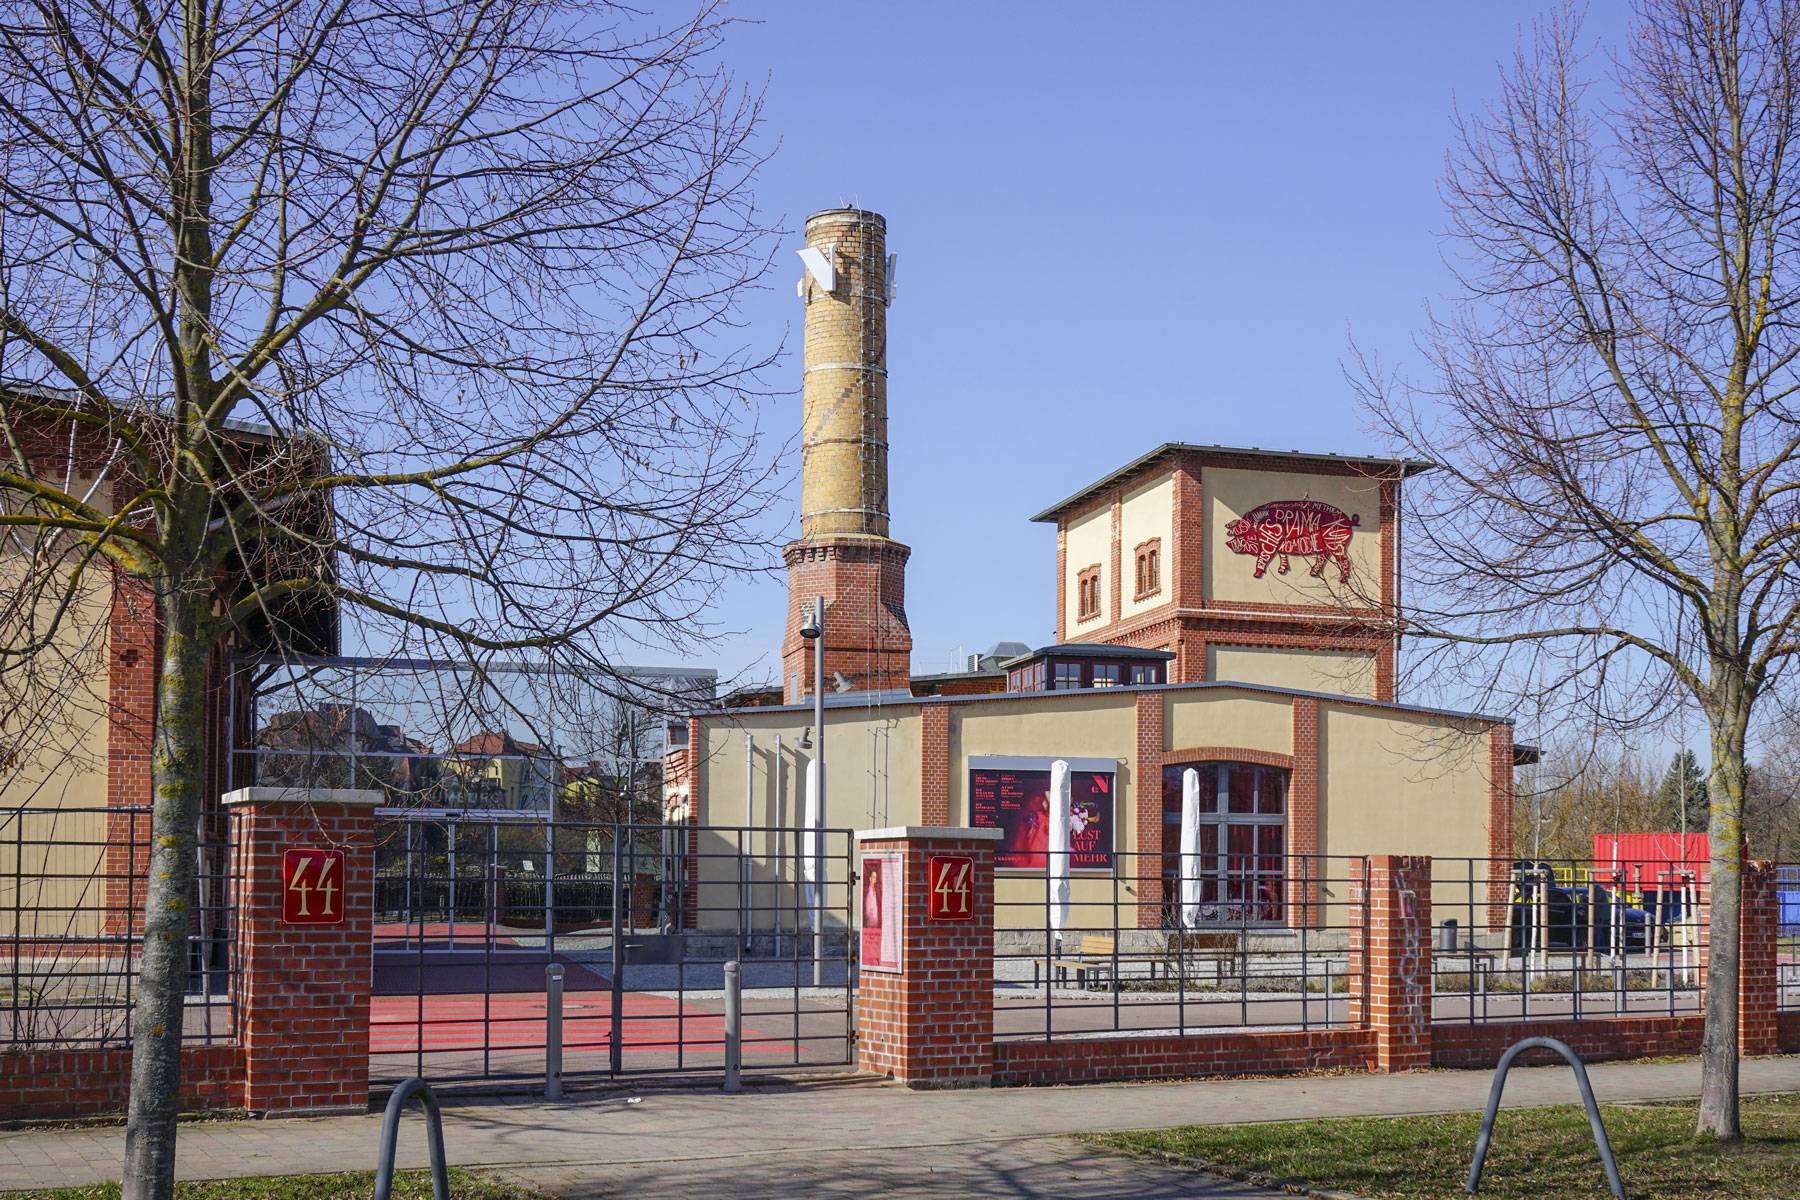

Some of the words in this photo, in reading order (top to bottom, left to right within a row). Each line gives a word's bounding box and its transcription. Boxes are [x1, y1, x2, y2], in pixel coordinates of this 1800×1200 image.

[1275, 509, 1321, 538] DRAMA
[1321, 518, 1350, 556] KUNST
[1258, 518, 1282, 570] EPISCHES
[1073, 830, 1101, 840] LUST
[1074, 841, 1096, 851] AUF
[289, 857, 339, 916] 44
[934, 863, 971, 913] 44
